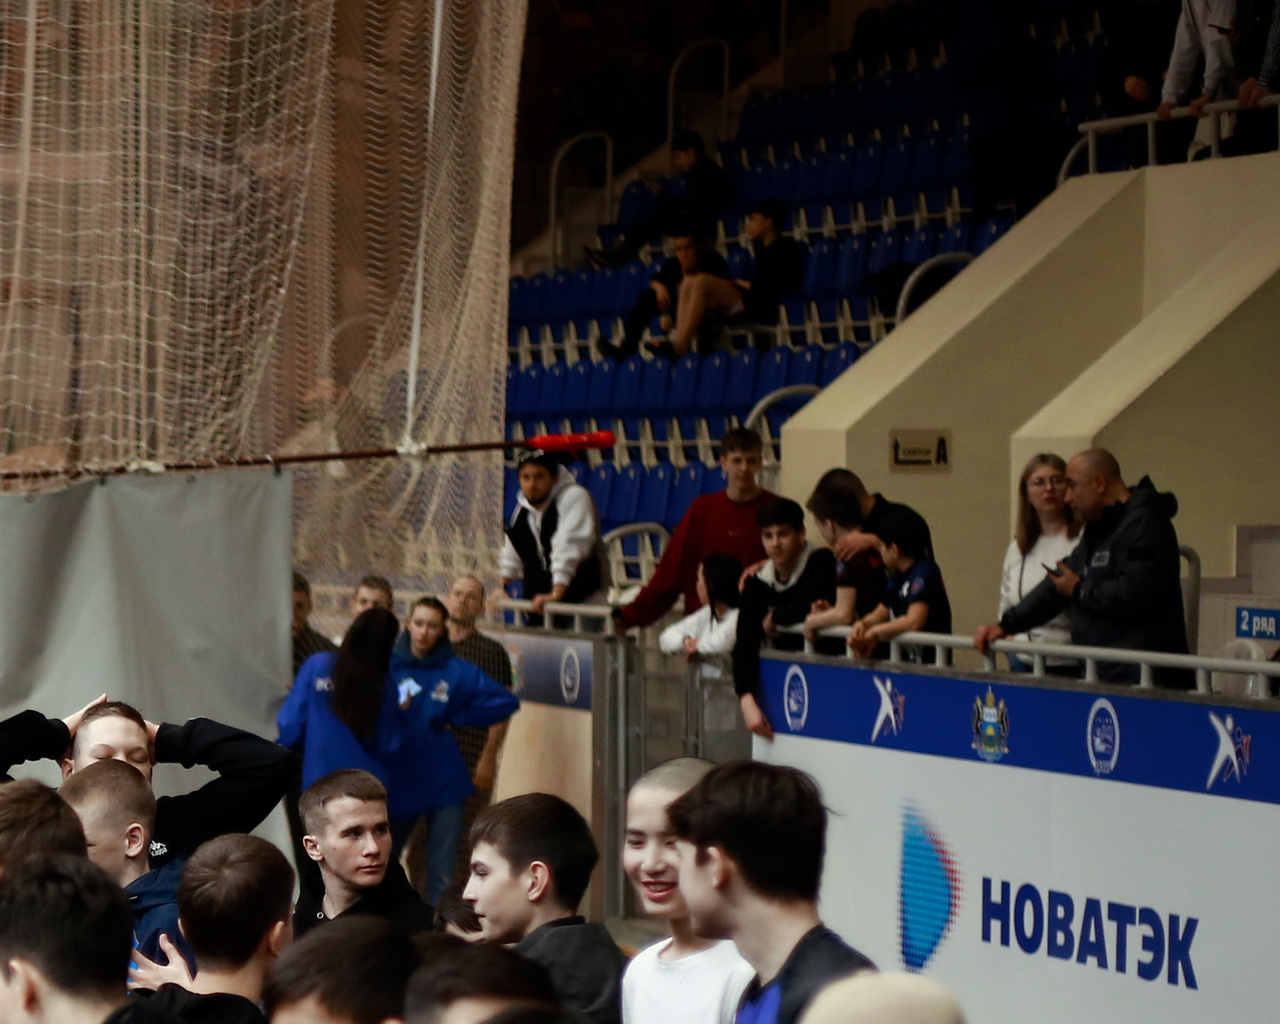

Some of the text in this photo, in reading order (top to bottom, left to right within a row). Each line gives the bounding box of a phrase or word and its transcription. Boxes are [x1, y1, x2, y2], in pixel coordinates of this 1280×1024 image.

[1241, 610, 1276, 637] 2 ряд
[981, 877, 1199, 990] НОВАТЭК
